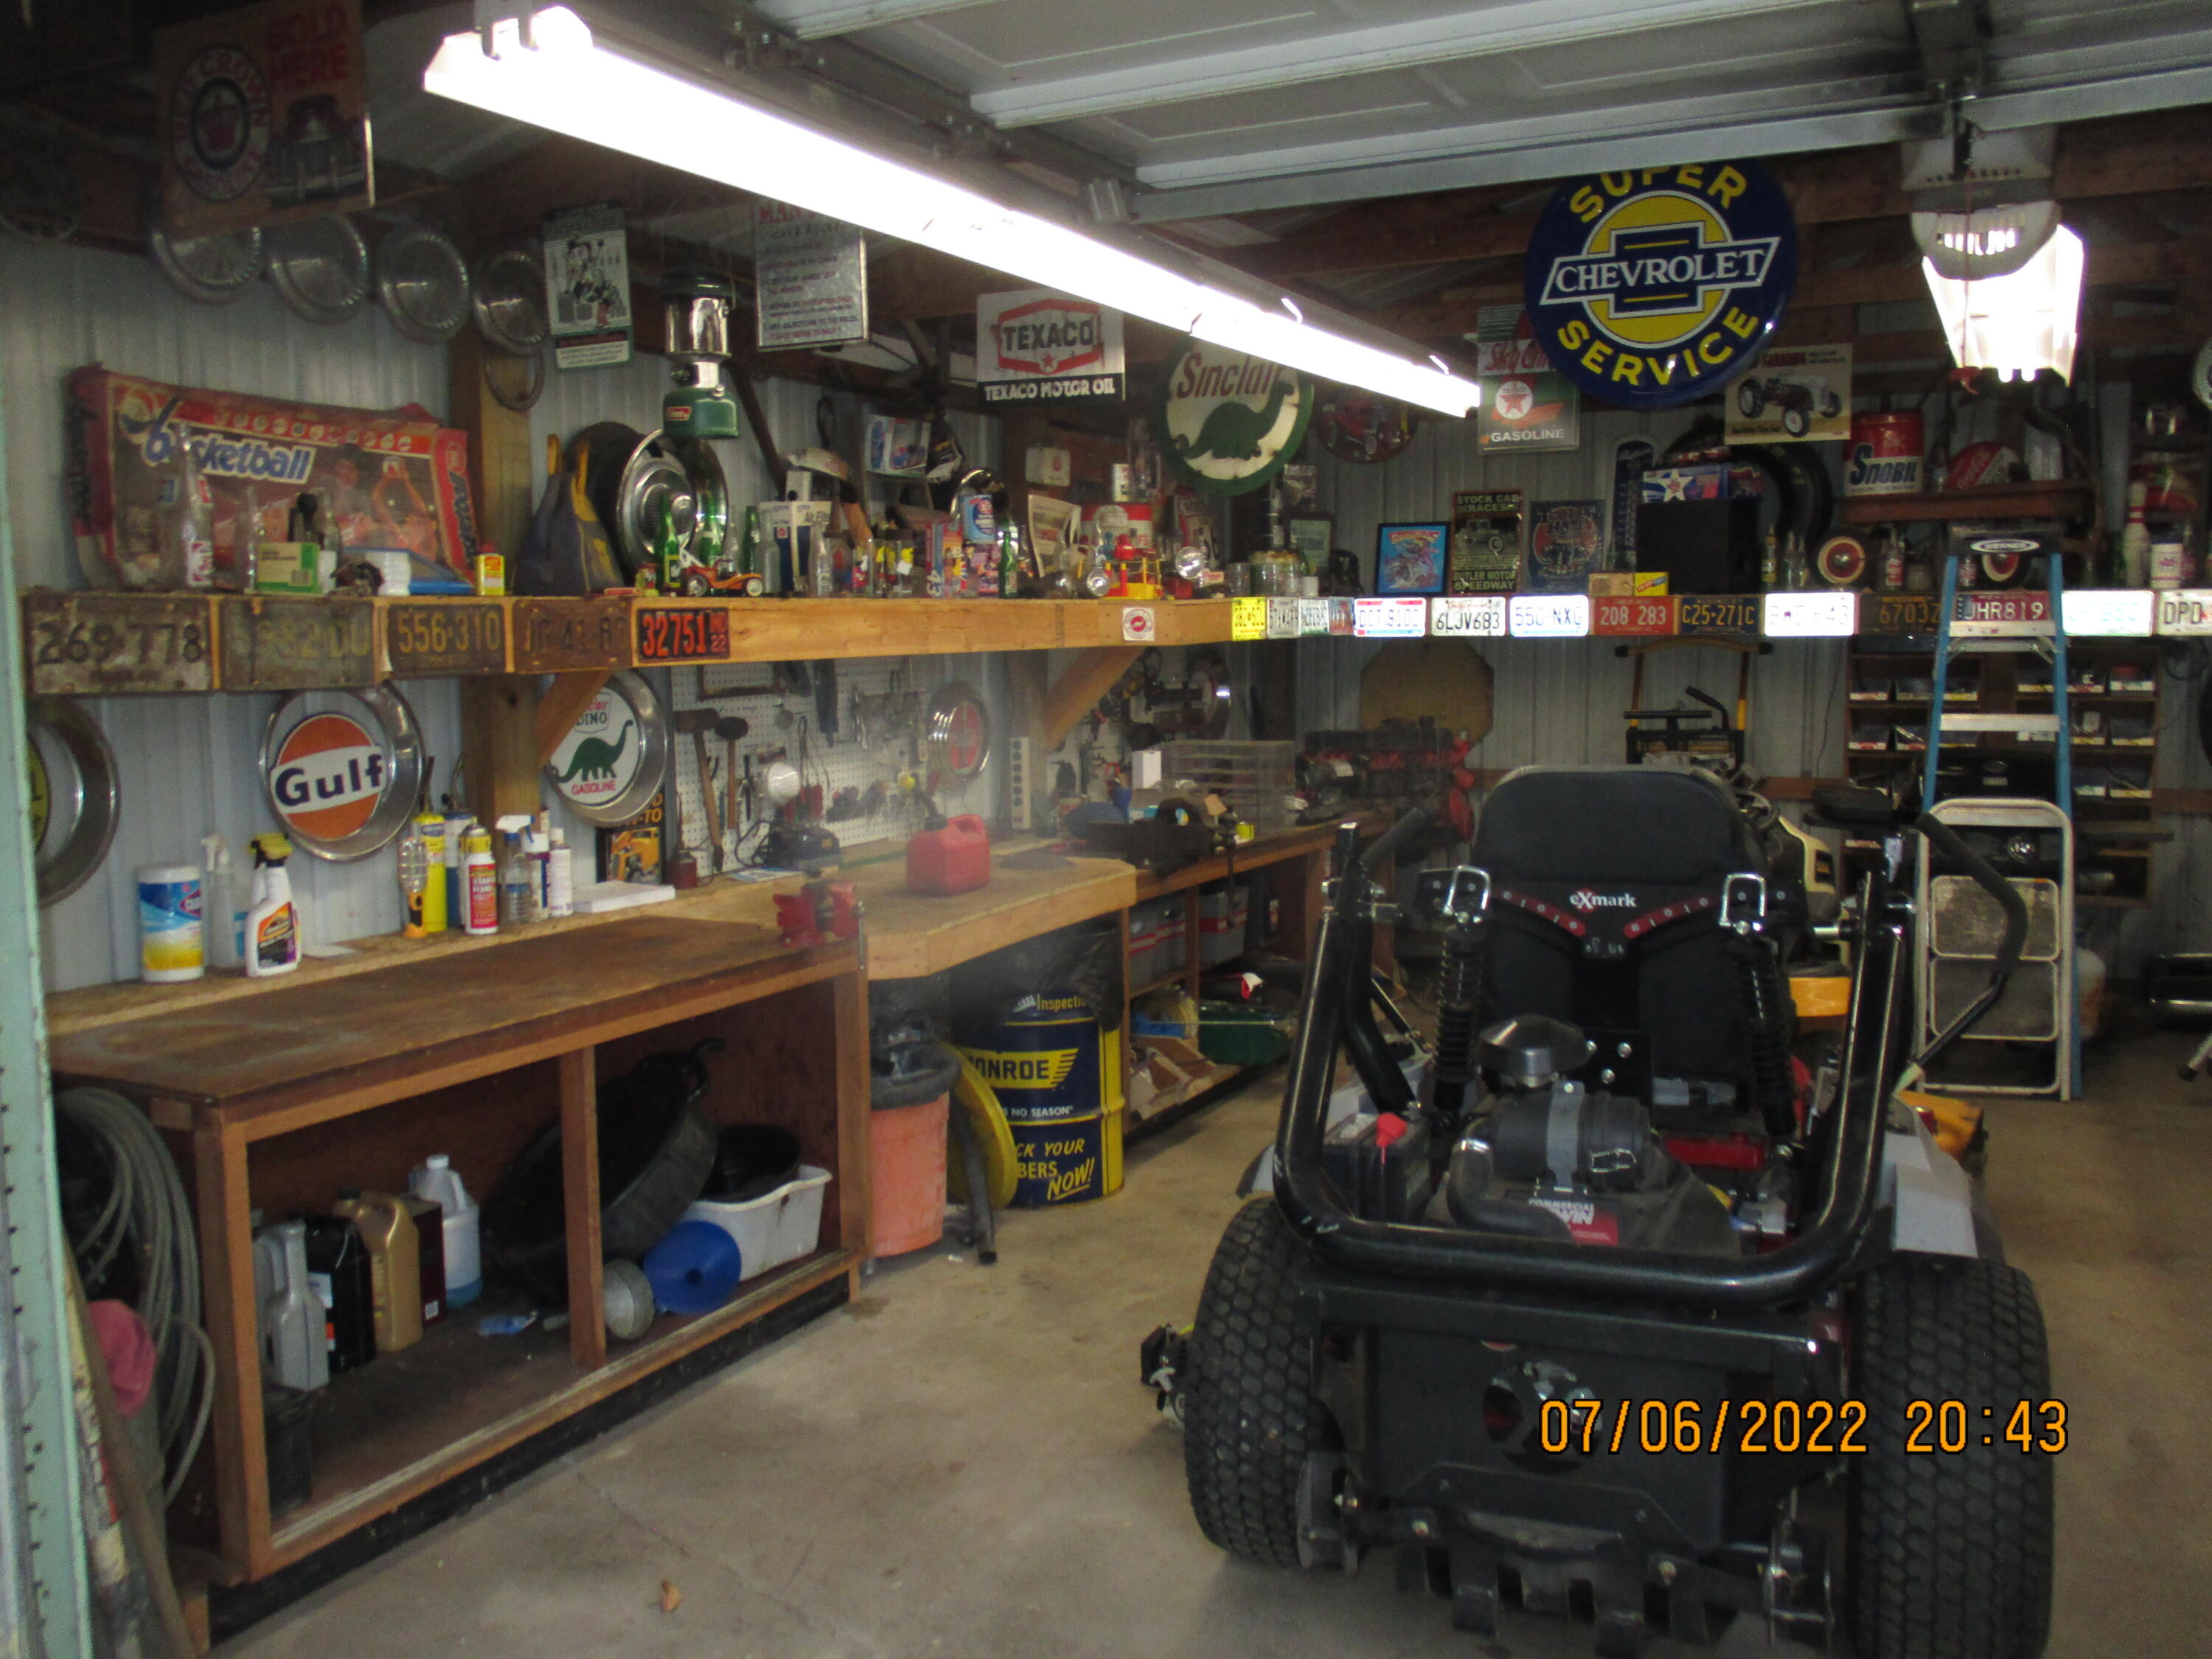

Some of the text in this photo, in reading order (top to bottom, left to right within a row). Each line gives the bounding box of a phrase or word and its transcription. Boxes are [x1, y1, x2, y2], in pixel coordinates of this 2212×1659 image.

[1569, 163, 1747, 223] SUPER
[1555, 249, 1765, 293] CHEVROLET
[1003, 319, 1094, 352] TEXACO
[1557, 306, 1759, 386] SERVICE
[984, 377, 1116, 402] TEXACO MOTOR OIL
[145, 398, 313, 481] bsketball
[1491, 429, 1565, 442] GASOLINE
[1457, 495, 1493, 504] STOCK
[1437, 611, 1500, 630] 6LJV683
[1638, 605, 1668, 625] 283
[642, 611, 706, 657] 32751
[275, 754, 383, 807] Gulf
[571, 779, 616, 796] GASOLINE
[968, 1056, 1049, 1080] ONROE
[1011, 1107, 1028, 1117] NO
[1044, 1138, 1085, 1157] YOUR
[1046, 1157, 1096, 1201] NOW!
